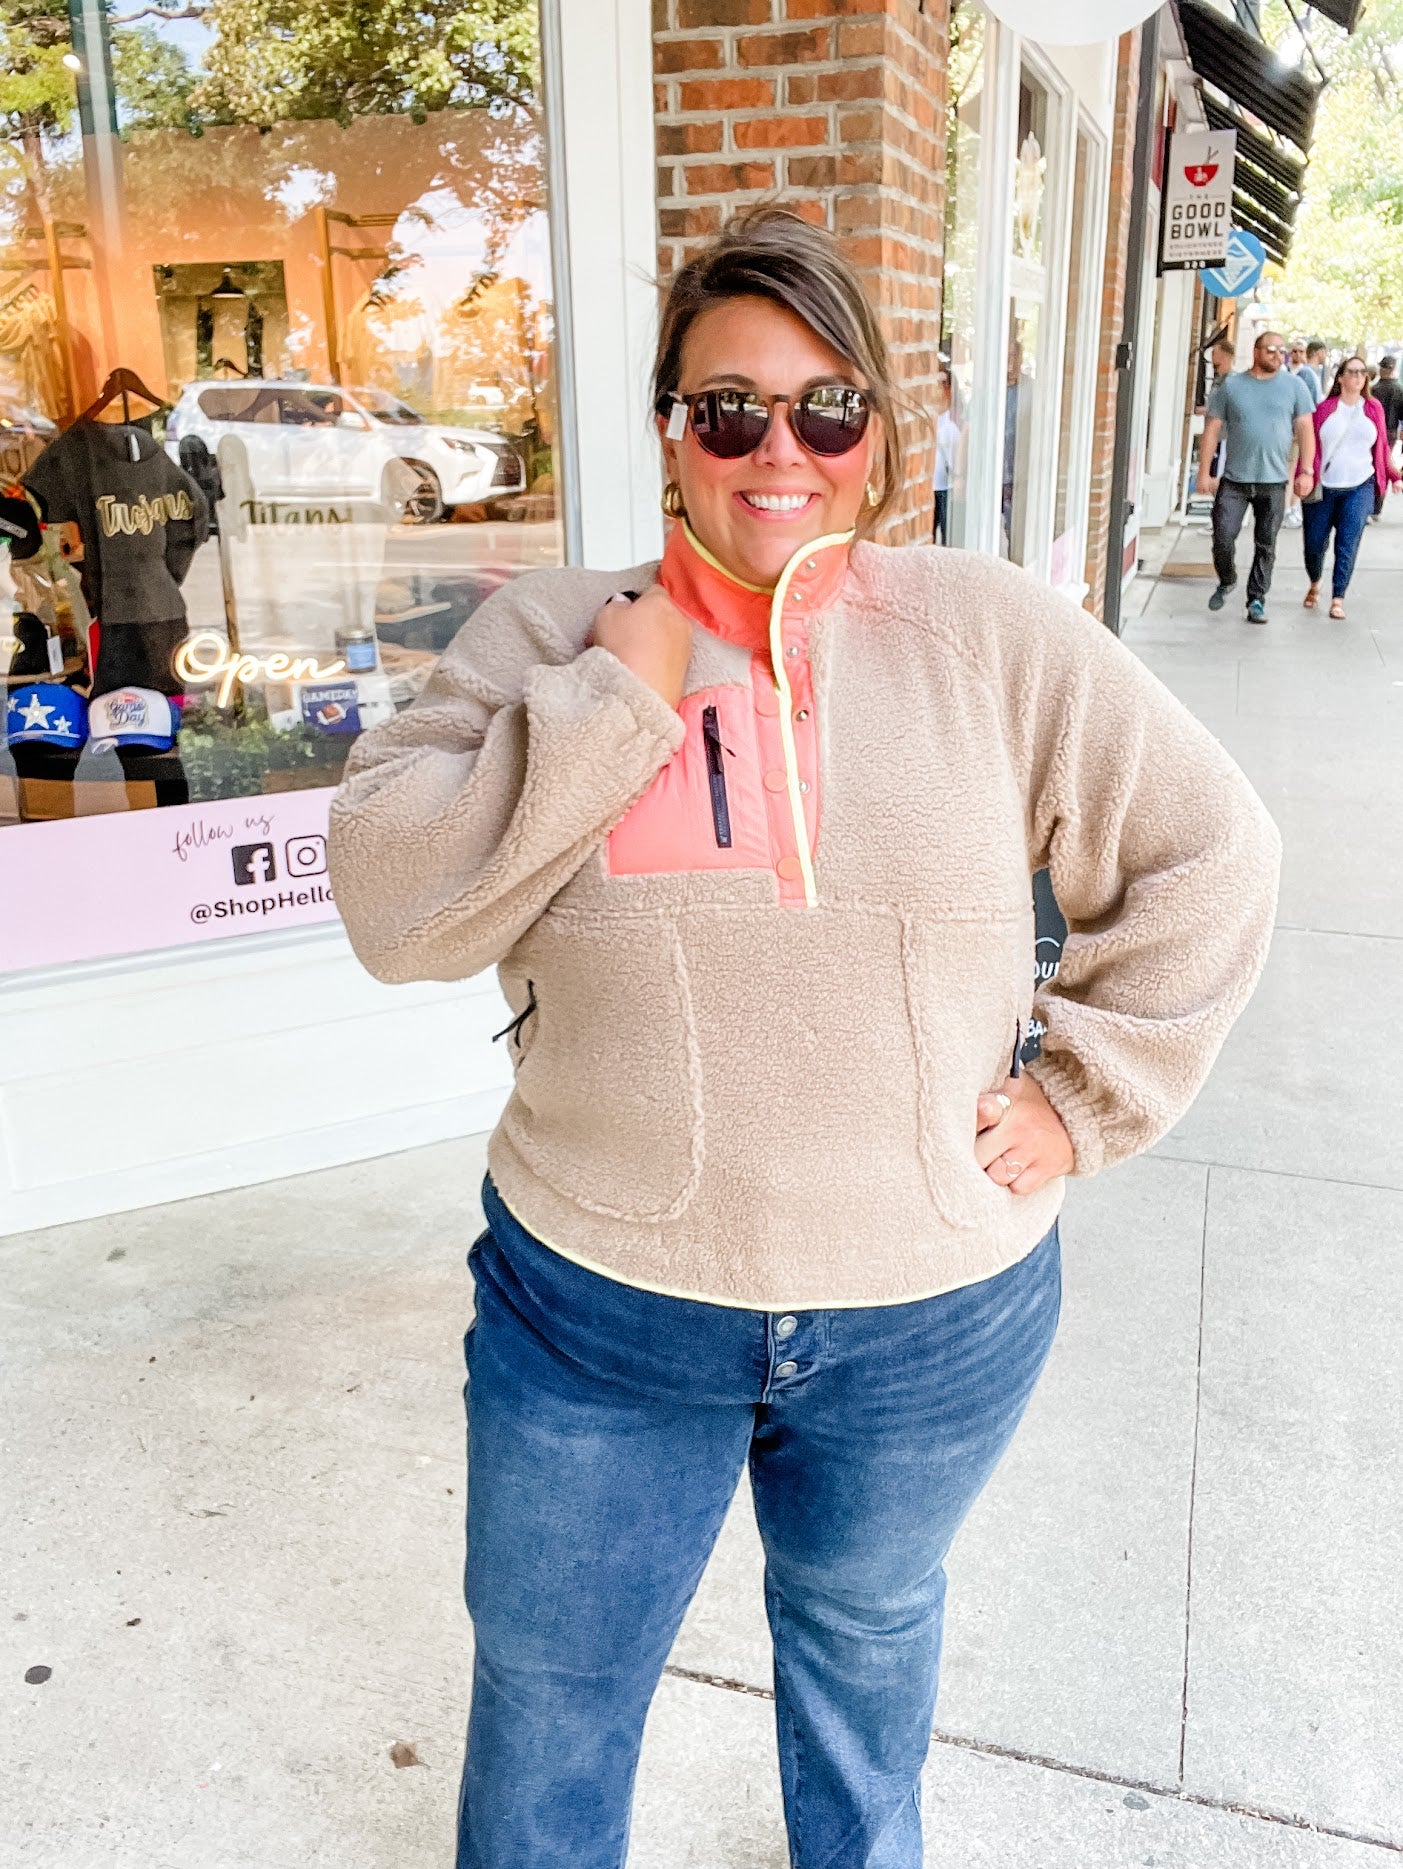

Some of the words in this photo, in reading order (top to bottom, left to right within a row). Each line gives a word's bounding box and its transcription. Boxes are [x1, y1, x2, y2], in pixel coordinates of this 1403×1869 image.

[1172, 202, 1225, 220] GOOD
[1171, 221, 1223, 239] BOWL
[96, 490, 194, 537] Trojans
[175, 632, 346, 709] Open
[112, 710, 146, 727] Day
[172, 819, 234, 862] follow
[245, 814, 275, 836] us
